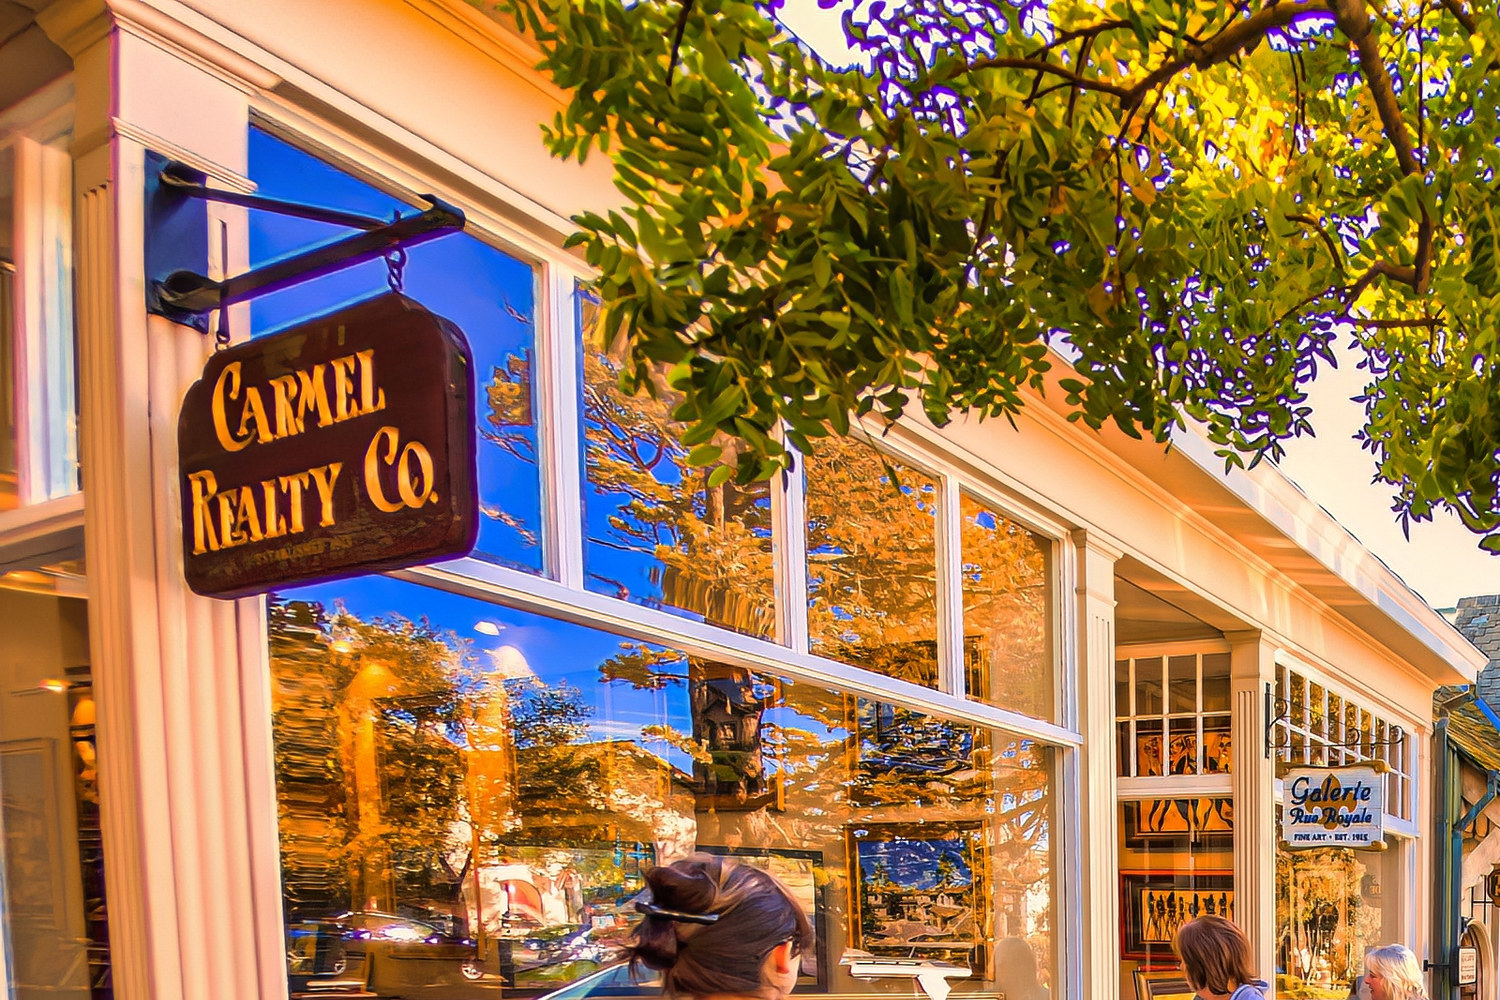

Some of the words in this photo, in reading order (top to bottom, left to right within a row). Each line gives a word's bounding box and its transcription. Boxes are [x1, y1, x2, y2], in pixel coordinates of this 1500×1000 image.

[1291, 776, 1371, 805] Galerie
[1290, 807, 1318, 825] Rue
[1322, 807, 1372, 828] Royale
